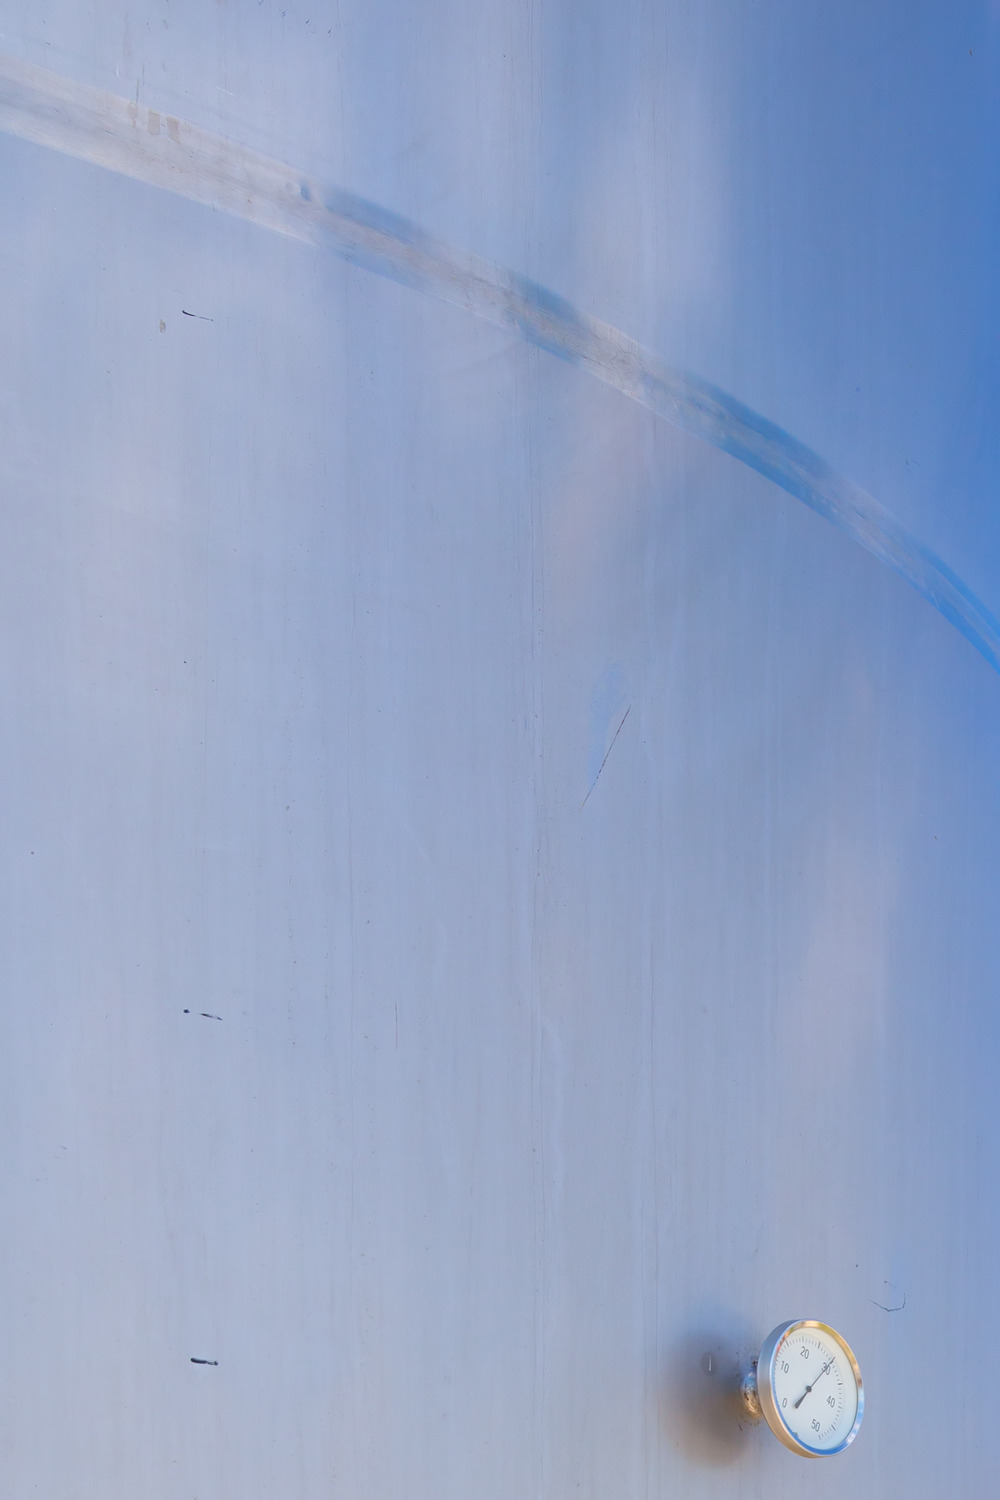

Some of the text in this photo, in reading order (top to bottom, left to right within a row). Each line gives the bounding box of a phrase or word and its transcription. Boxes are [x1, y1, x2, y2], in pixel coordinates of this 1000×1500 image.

[800, 1346, 809, 1359] 20
[780, 1360, 789, 1373] 10
[782, 1397, 788, 1408] 0
[826, 1395, 835, 1408] 40
[811, 1419, 820, 1432] 50
